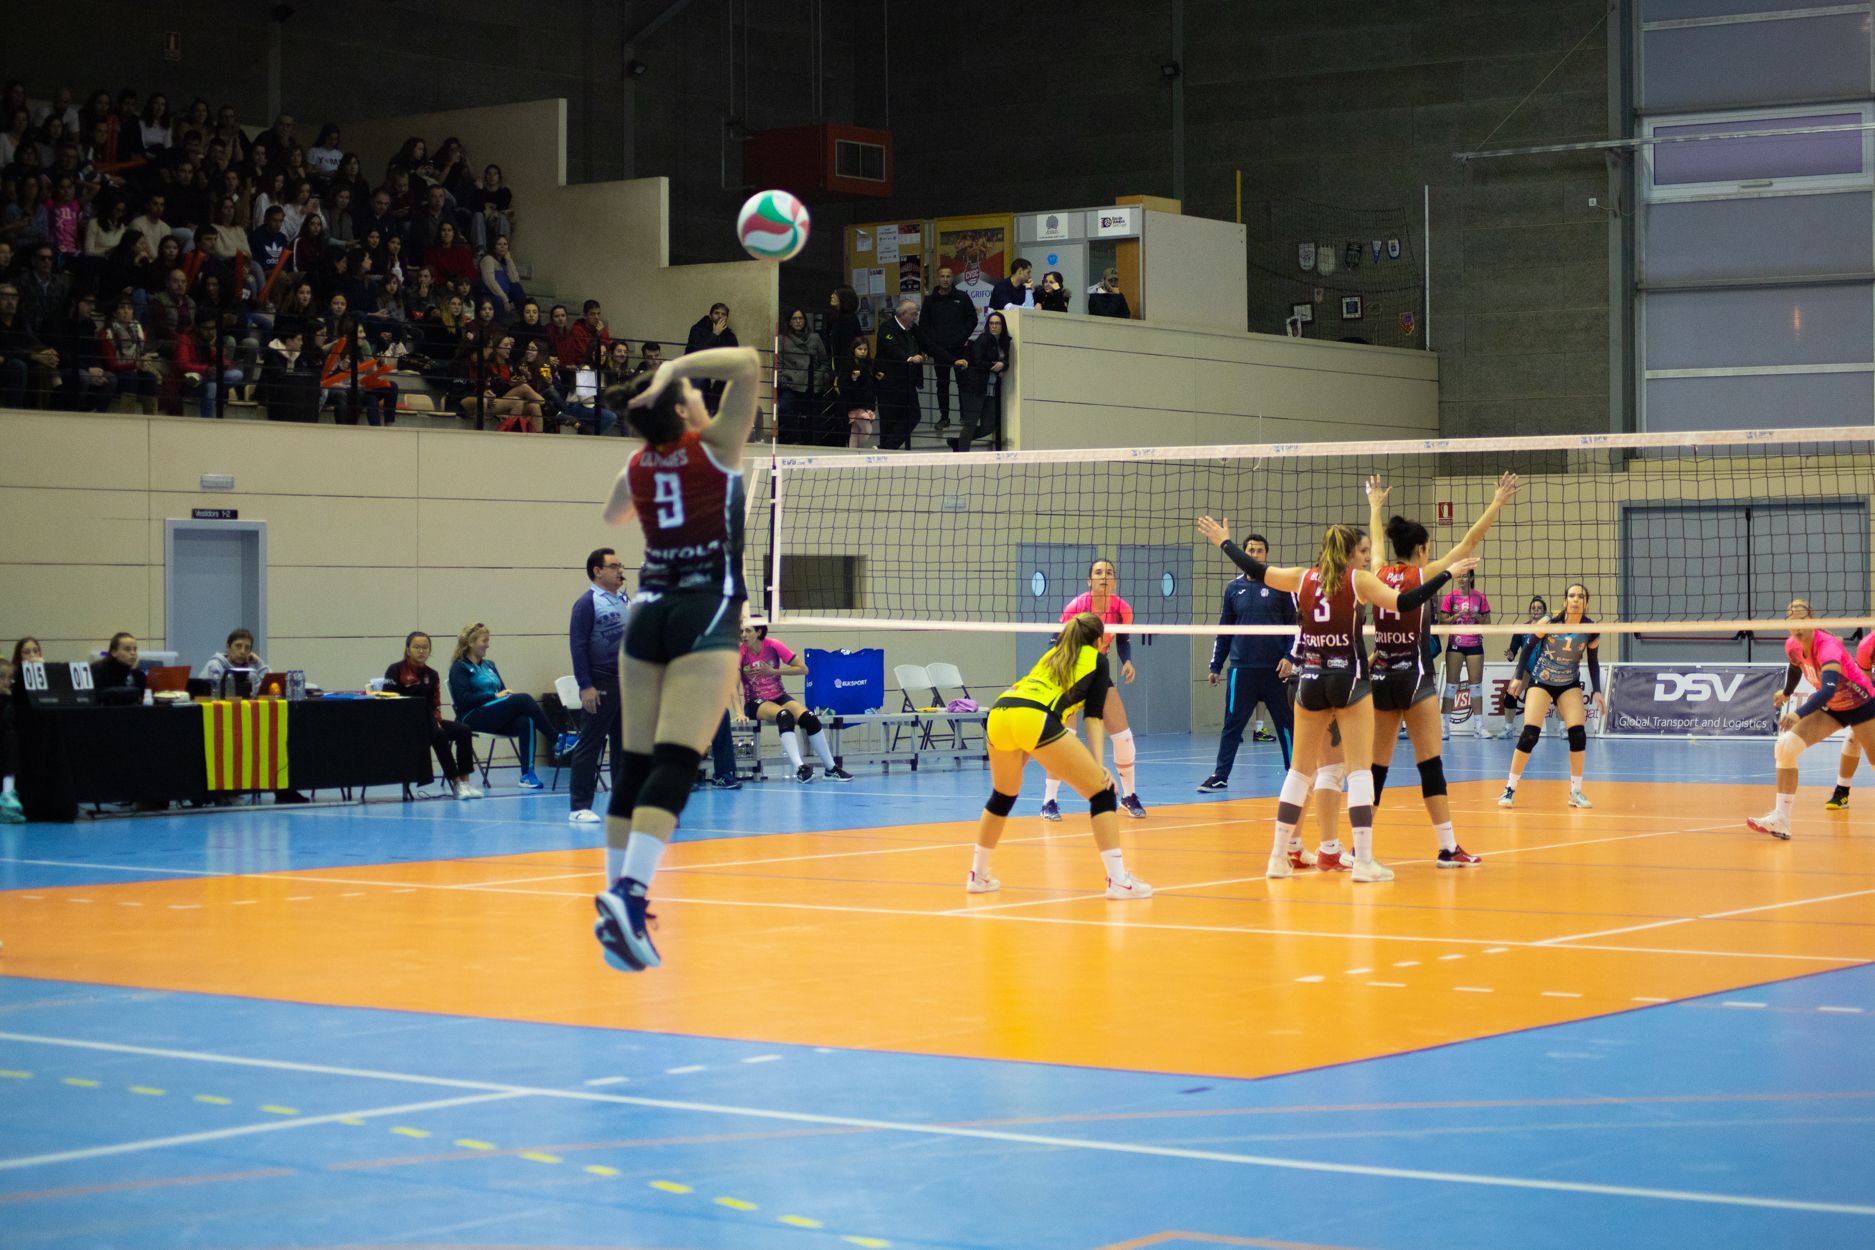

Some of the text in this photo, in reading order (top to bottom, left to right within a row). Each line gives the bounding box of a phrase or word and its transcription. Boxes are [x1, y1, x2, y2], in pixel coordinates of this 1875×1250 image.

[970, 290, 991, 299] GRIFO
[654, 472, 684, 529] 9
[1313, 586, 1331, 622] 3
[1306, 633, 1350, 648] GRIFOLS
[1562, 636, 1573, 651] 1
[1653, 673, 1746, 702] DSV
[1618, 716, 1768, 731] Global Transport and Logistics
